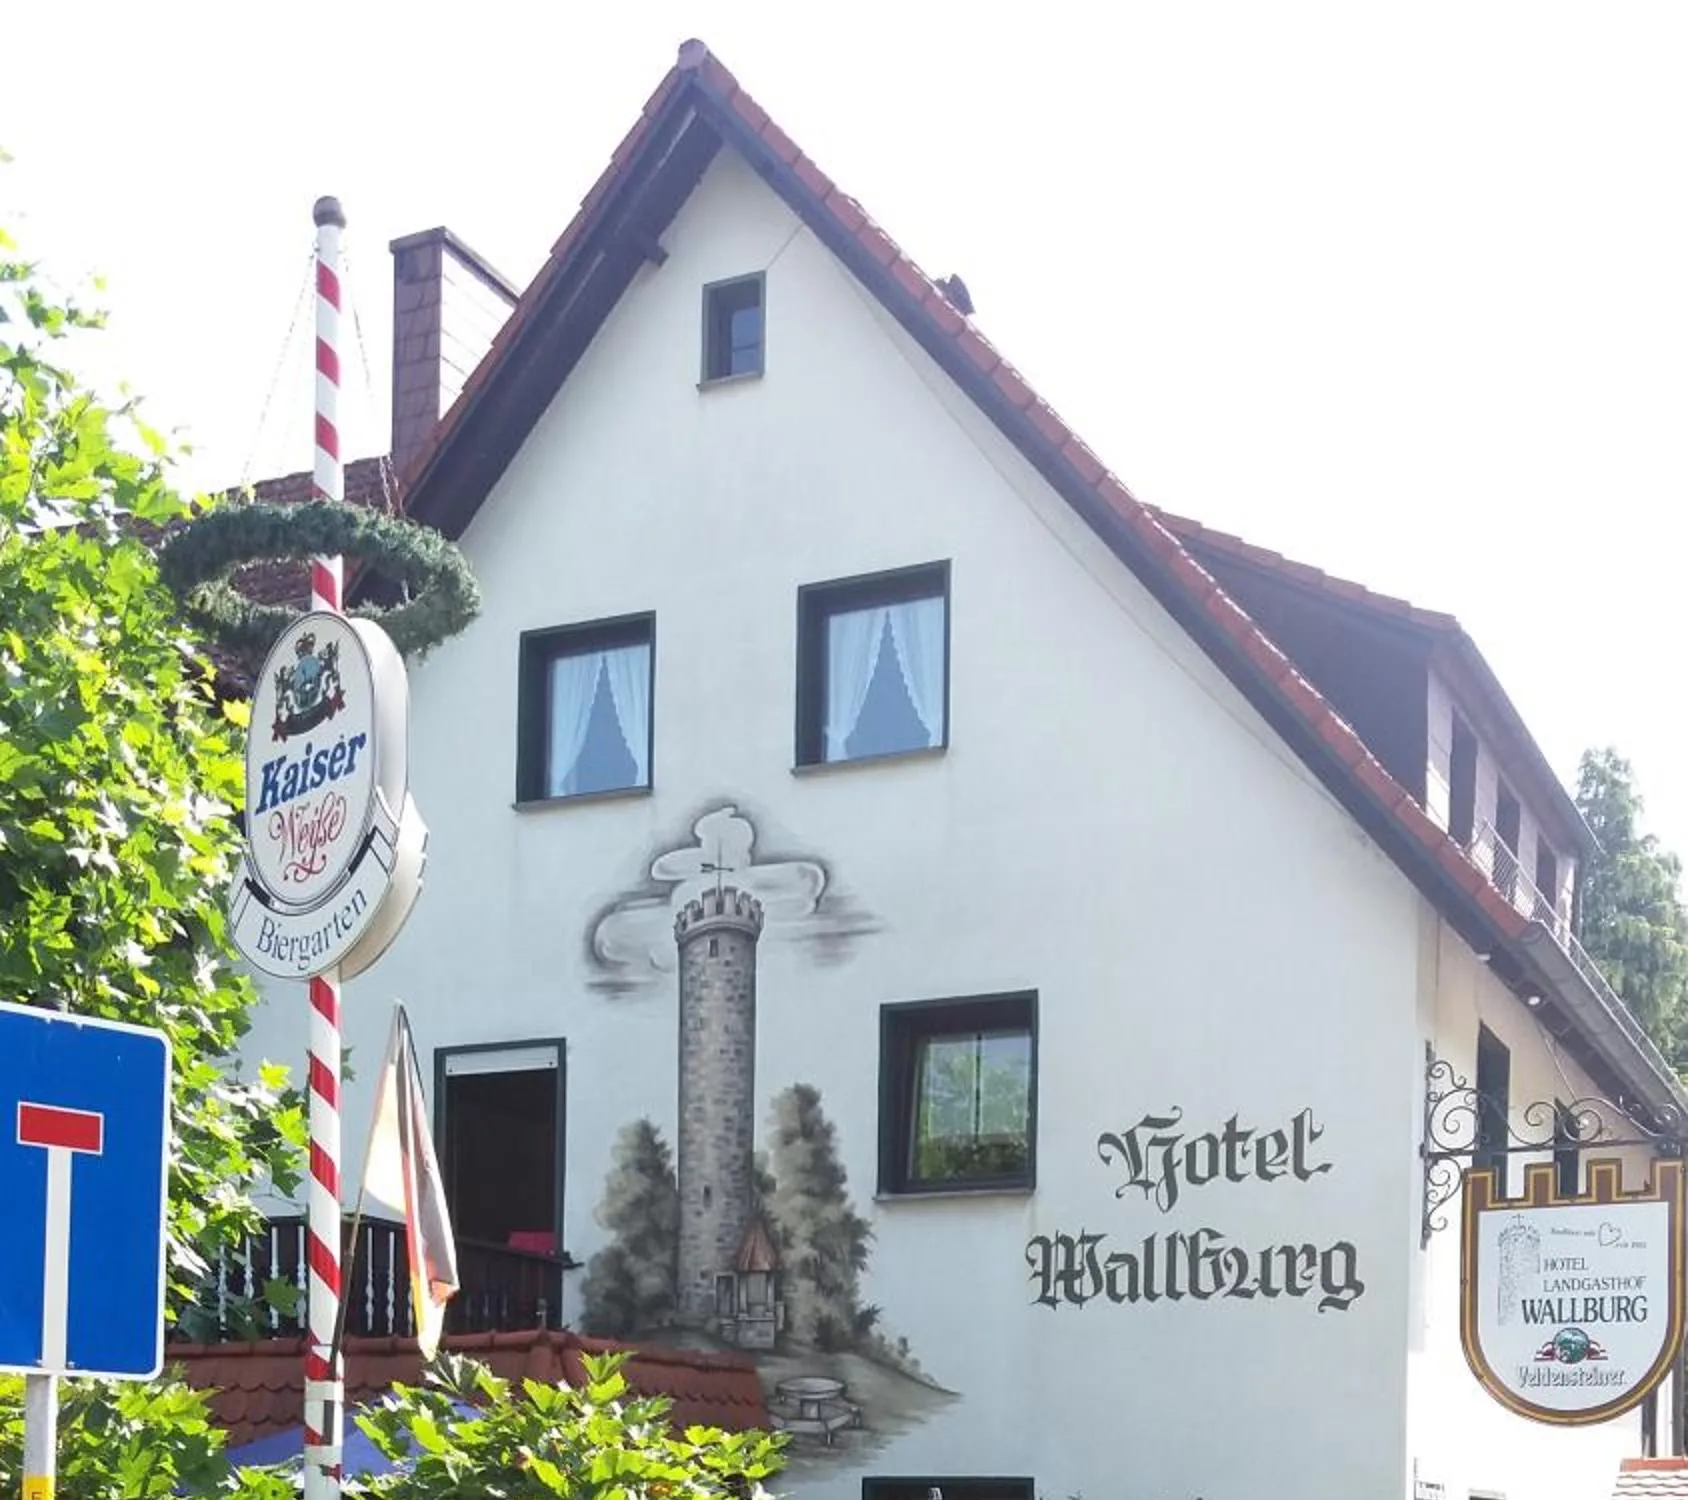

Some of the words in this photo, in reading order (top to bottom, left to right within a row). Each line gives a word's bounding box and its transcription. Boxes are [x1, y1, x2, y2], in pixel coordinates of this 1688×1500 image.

[255, 732, 368, 816] Kaiser
[256, 887, 368, 971] Biergarten
[1097, 1105, 1334, 1213] Hotel
[1025, 1227, 1365, 1313] Wallburg
[1543, 1257, 1588, 1272] HOTEL
[1543, 1275, 1647, 1292] LANDGASTHOF
[1521, 1295, 1648, 1325] WALLBURG
